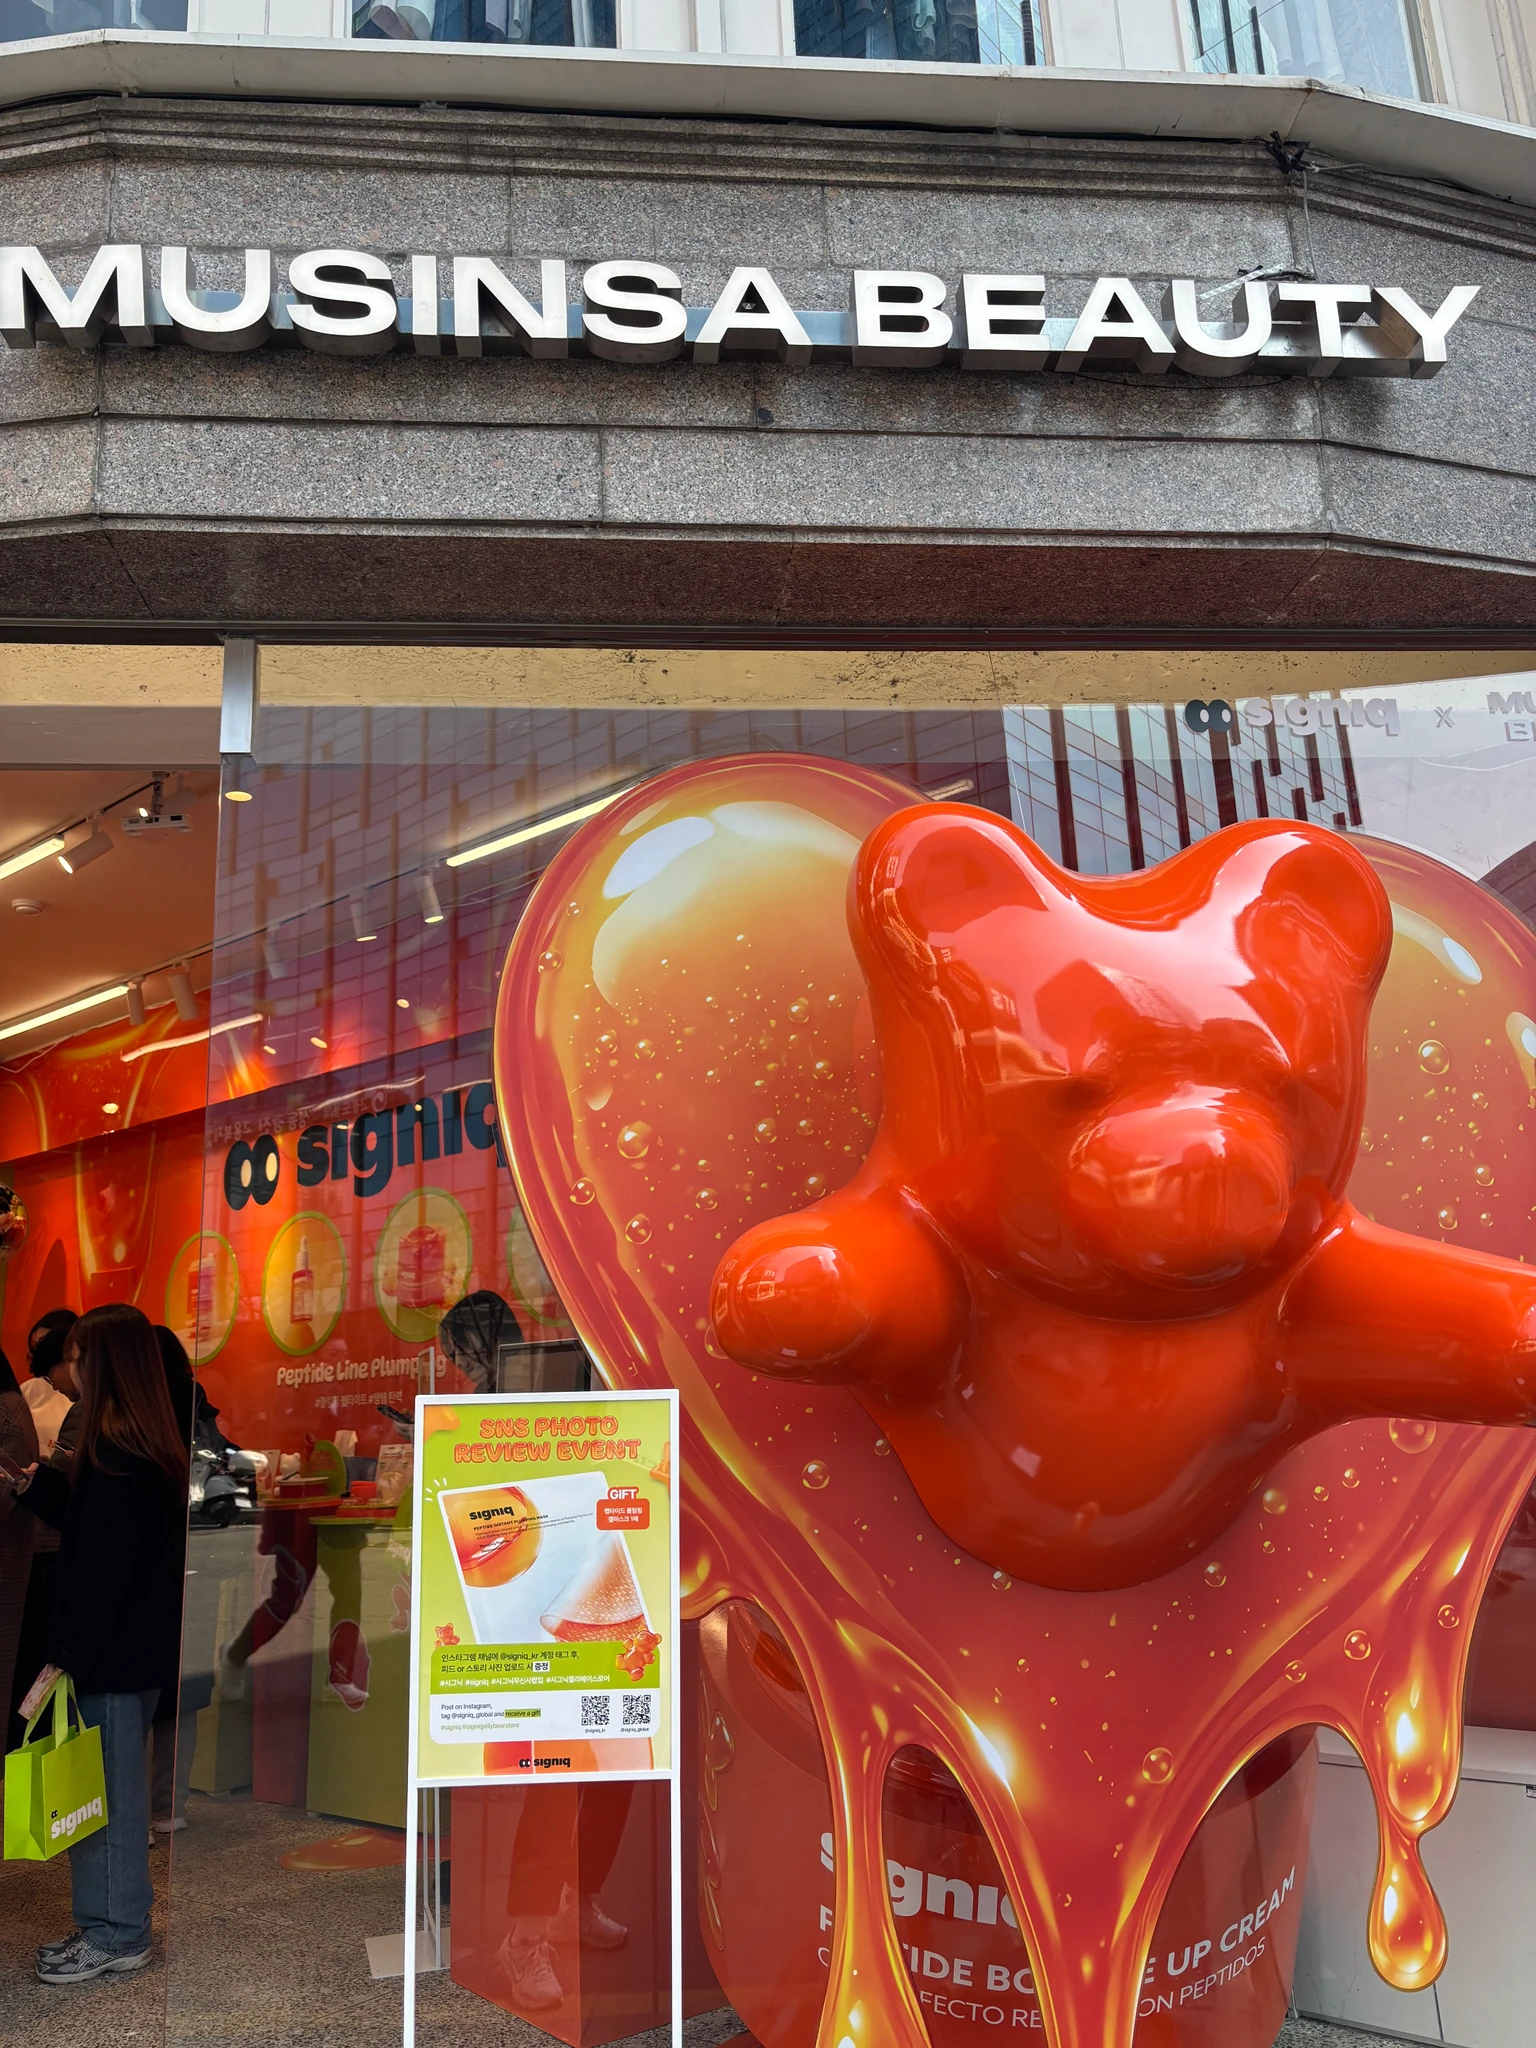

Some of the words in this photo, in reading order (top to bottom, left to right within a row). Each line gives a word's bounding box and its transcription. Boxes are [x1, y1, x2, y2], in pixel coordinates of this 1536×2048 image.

[0, 244, 813, 347] MUSINSA
[853, 270, 1482, 362] BEAUTY
[1244, 694, 1401, 737] signiq
[297, 1082, 507, 1199] signiq
[276, 1361, 335, 1389] Peptide
[336, 1359, 369, 1382] Line
[370, 1354, 447, 1380] Plumpg
[479, 1417, 530, 1439] SNS
[534, 1415, 619, 1438] PHOTO
[453, 1441, 551, 1464] REVIEW
[556, 1439, 642, 1462] EVENT
[610, 1489, 637, 1500] GIFT
[469, 1506, 514, 1521] signiq
[493, 1520, 513, 1528] INSTANT
[441, 1653, 477, 1662] 인스타그램
[477, 1652, 499, 1661] 채널에
[500, 1651, 539, 1661] @signiq_kr
[540, 1651, 555, 1660] 계정
[555, 1651, 569, 1660] 태그
[570, 1650, 580, 1660] 후,
[441, 1664, 456, 1673] 피드
[466, 1664, 486, 1672] 스토리
[488, 1663, 502, 1672] 사진
[504, 1663, 525, 1672] 업로드
[526, 1663, 533, 1671] 시
[534, 1662, 549, 1671] 증정
[440, 1678, 463, 1687] #시그닉
[465, 1678, 489, 1687] #signiq
[451, 1711, 493, 1719] @signiq_global
[531, 1709, 541, 1717] gift
[533, 1757, 571, 1769] signiq
[50, 1796, 103, 1839] signiq
[1167, 1939, 1212, 1977] UP
[1219, 1864, 1296, 1953] CREAM
[1179, 1935, 1266, 2006] PEPTIDOS
